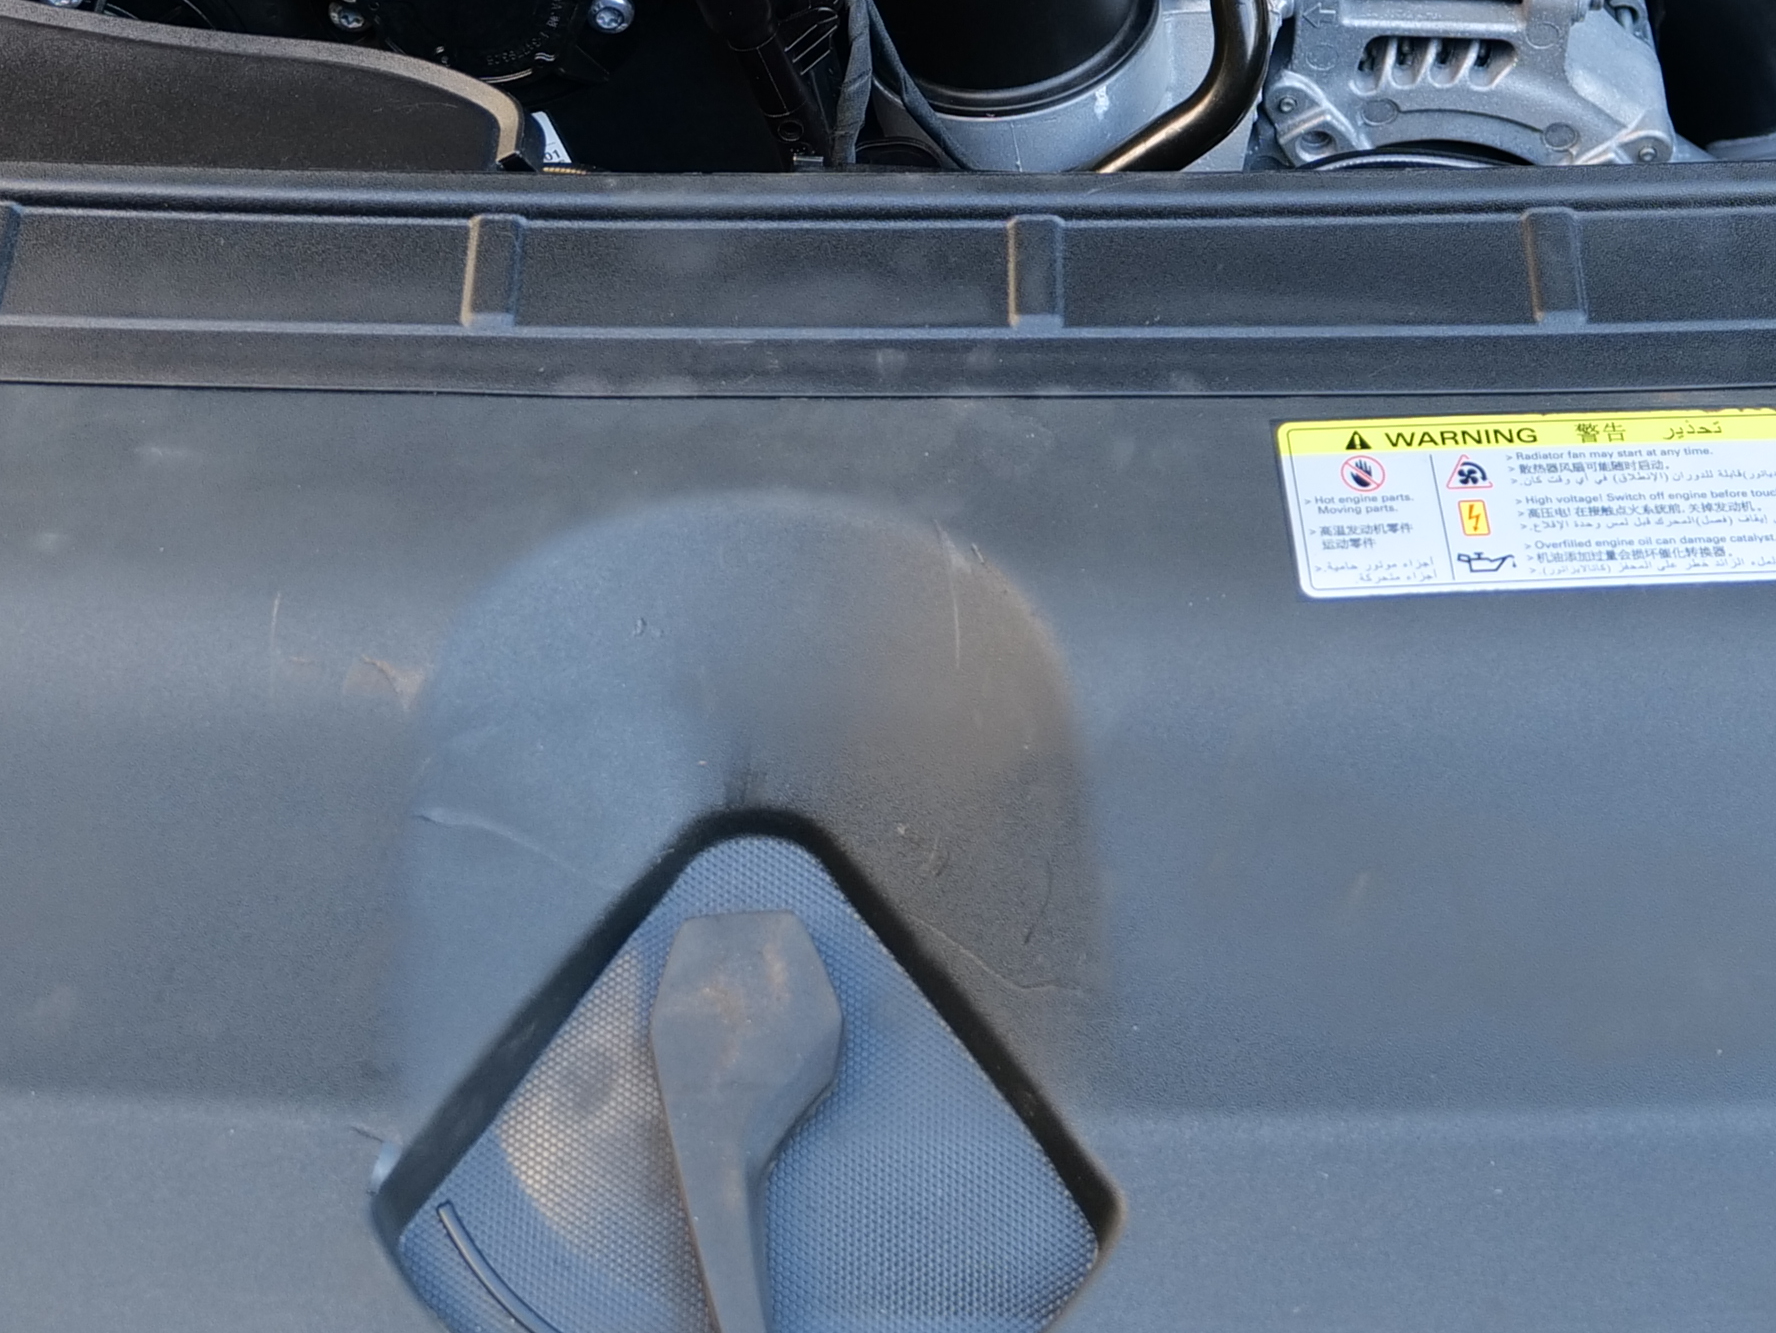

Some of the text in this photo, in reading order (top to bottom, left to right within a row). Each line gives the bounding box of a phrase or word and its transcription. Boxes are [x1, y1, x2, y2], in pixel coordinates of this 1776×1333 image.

[1575, 421, 1626, 443] 警告
[1663, 419, 1722, 441] تحذير
[1384, 428, 1538, 447] WARNING
[1516, 447, 1713, 461] Radiator fan may start at any time.
[1315, 493, 1414, 505] Hot engine parts.
[1525, 495, 1553, 506] High
[1556, 494, 1603, 505] voltage!
[1606, 492, 1645, 502] Switch
[1649, 491, 1664, 500] off
[1668, 490, 1707, 501] engine
[1710, 489, 1748, 498] before
[1318, 504, 1398, 515] Moving parts.
[1320, 522, 1413, 537] 高温发动机零件
[1322, 537, 1376, 550] 运动零件
[1534, 538, 1592, 549] Overfilled
[1595, 537, 1635, 548] engine
[1637, 536, 1652, 546] oil
[1655, 536, 1676, 545] can
[1679, 535, 1727, 545] damage
